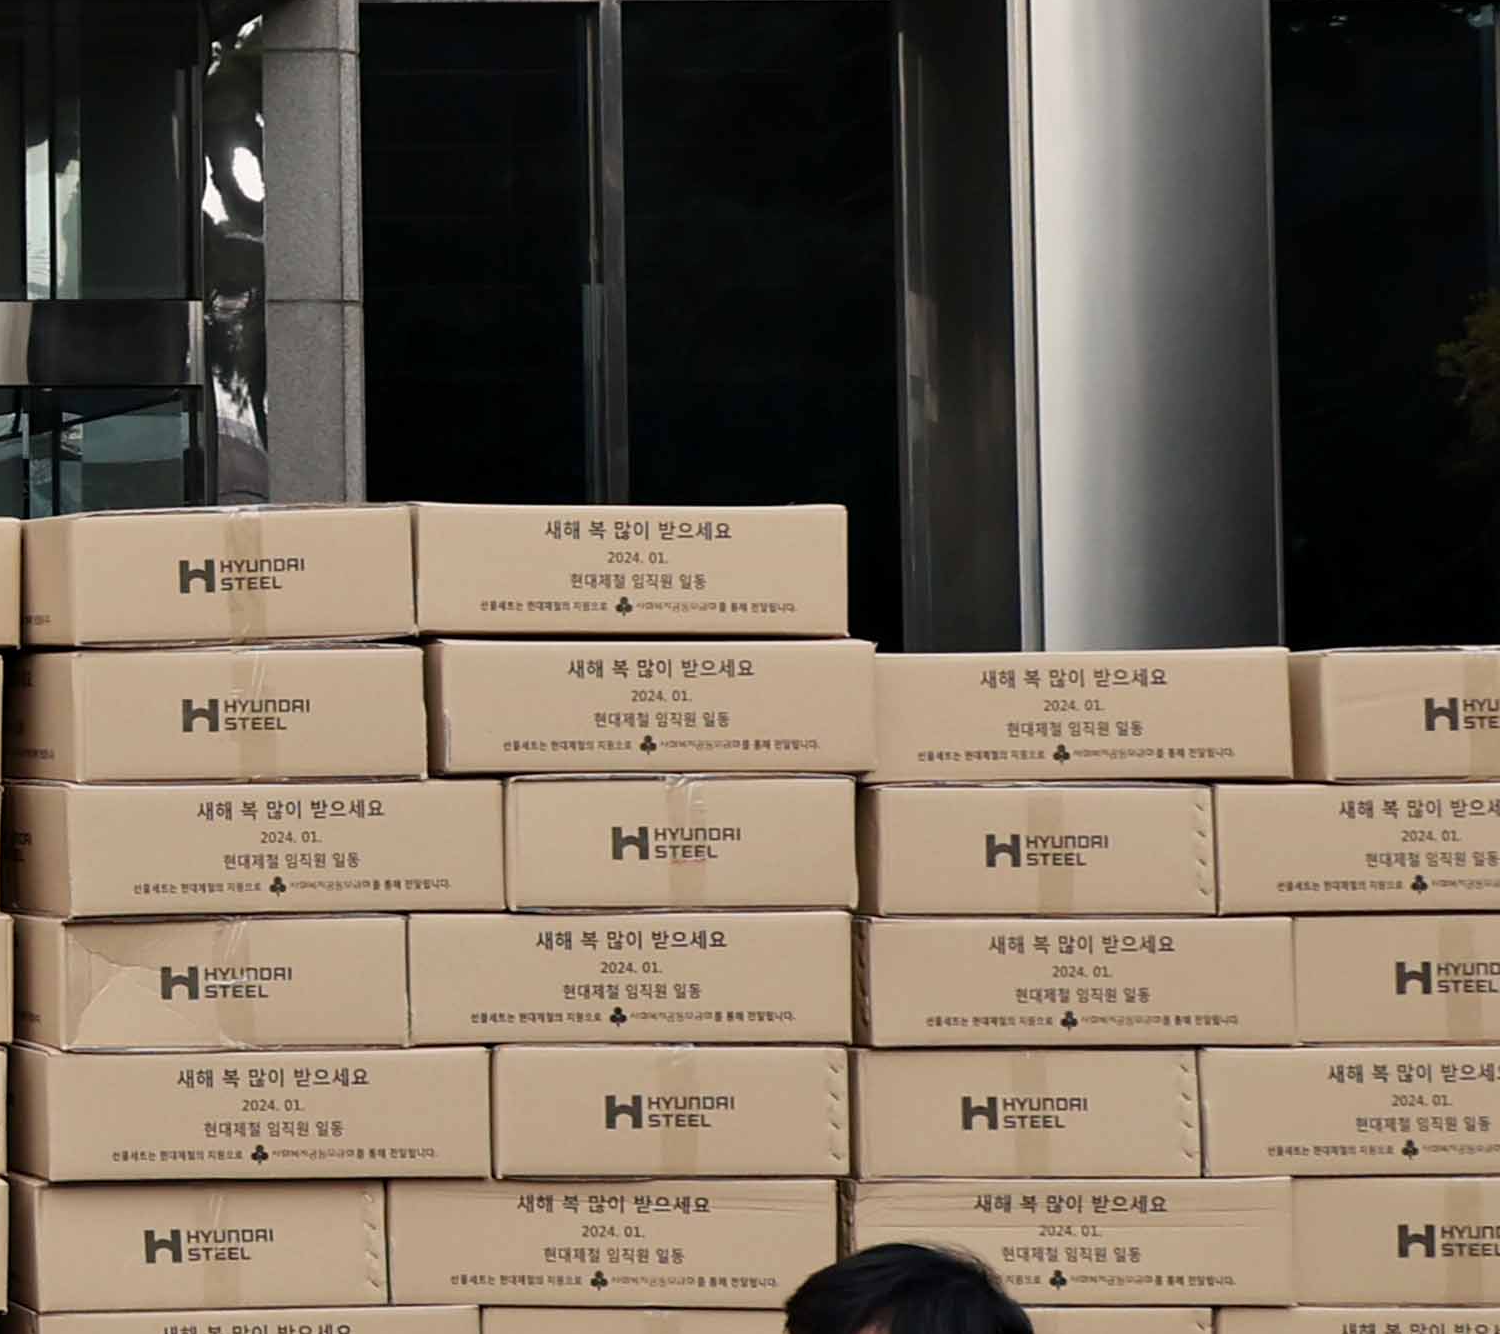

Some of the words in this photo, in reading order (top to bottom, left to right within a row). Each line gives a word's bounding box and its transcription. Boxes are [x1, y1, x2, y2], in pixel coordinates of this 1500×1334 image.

[981, 670, 1015, 688] 새해
[1024, 670, 1040, 688] 복
[1049, 669, 1084, 688] 많이
[1094, 669, 1167, 687] 받으세요
[1044, 700, 1078, 711] 2024.
[1084, 699, 1104, 711] 01.
[1007, 722, 1061, 737] 현대제철
[1068, 721, 1109, 737] 임직원
[1116, 721, 1142, 736] 일동
[1027, 835, 1108, 848] HYUNDAI
[1027, 853, 1086, 866] STEEL
